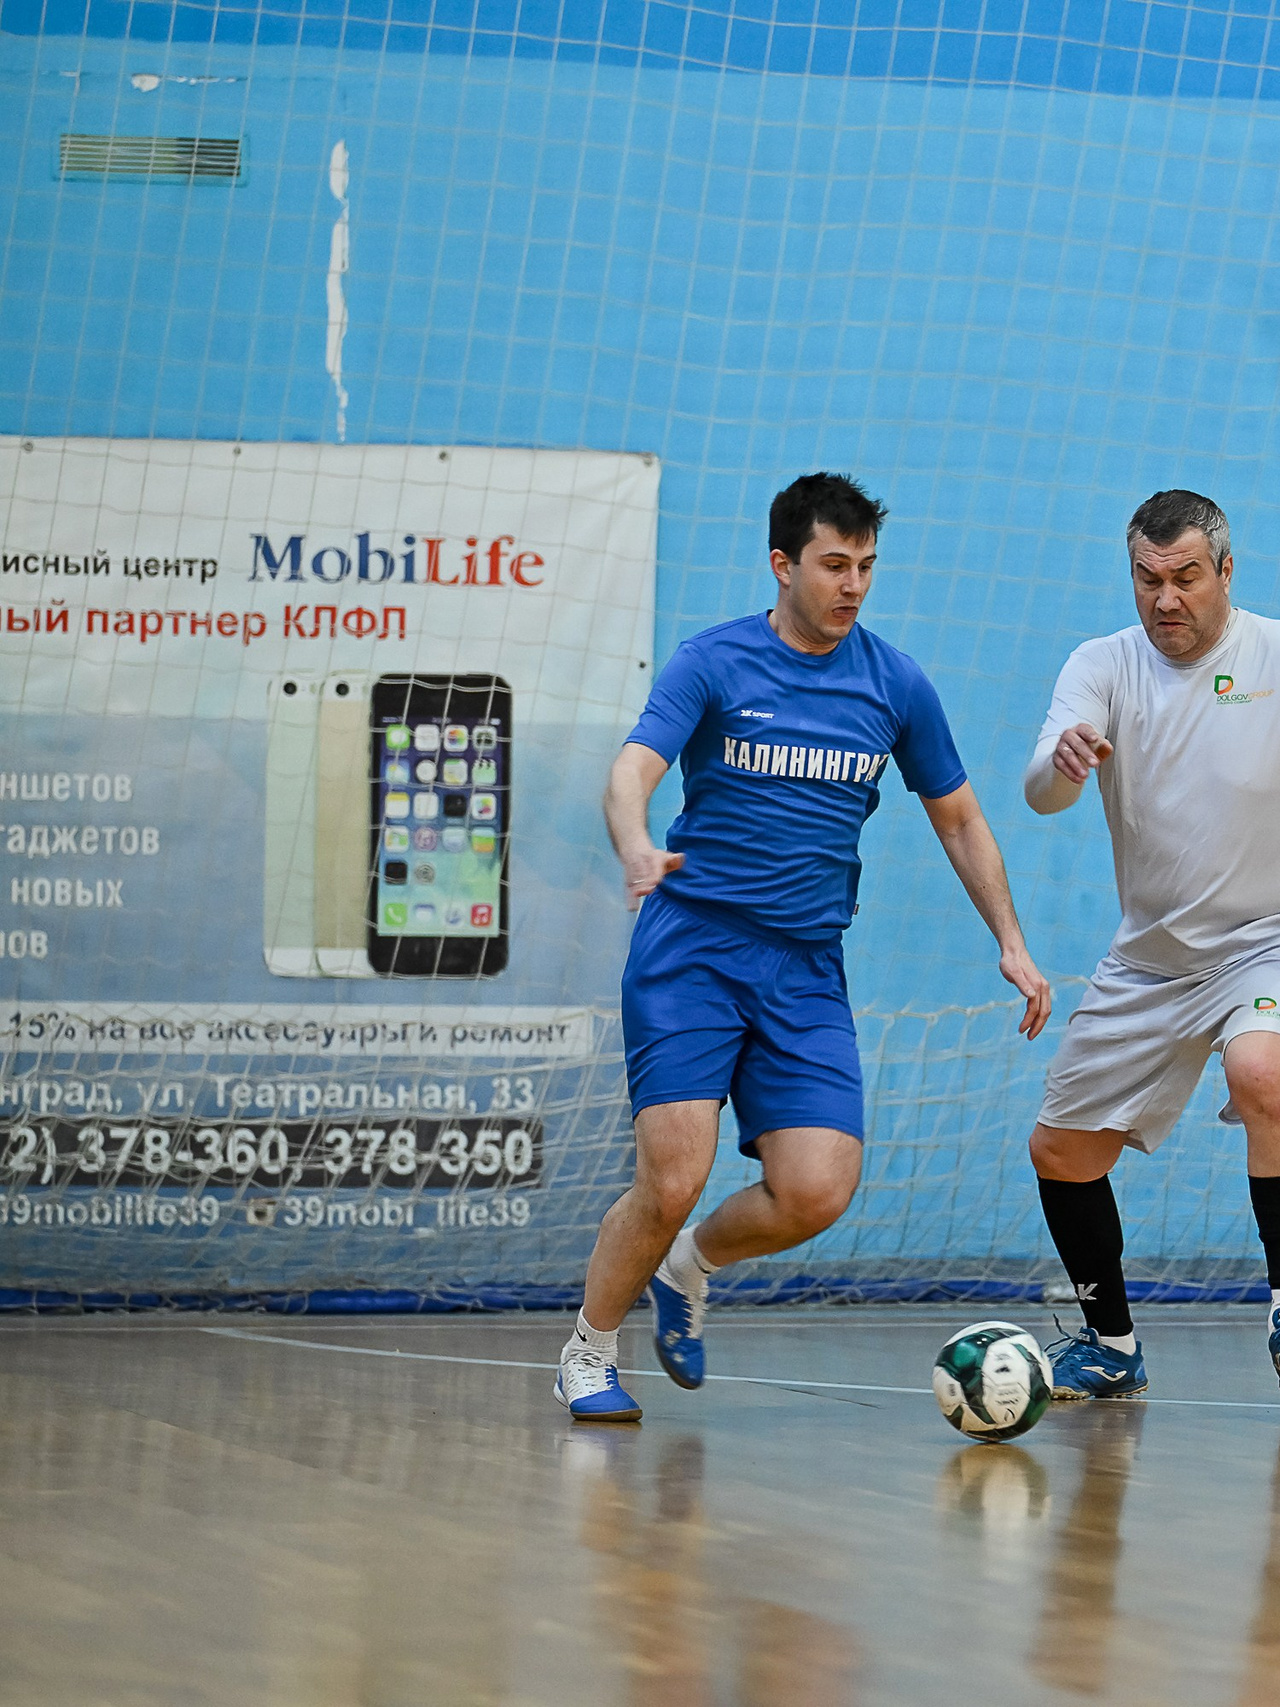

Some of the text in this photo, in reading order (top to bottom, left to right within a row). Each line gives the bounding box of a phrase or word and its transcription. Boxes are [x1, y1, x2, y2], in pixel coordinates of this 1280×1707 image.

[123, 556, 219, 584] центр
[248, 531, 546, 588] MobiLife
[0, 598, 407, 646] ый партнер КЛФЛ
[11, 876, 124, 907] новых
[214, 1075, 478, 1116] Театральная,
[491, 1076, 535, 1111] 33
[324, 1128, 533, 1176] 378-350
